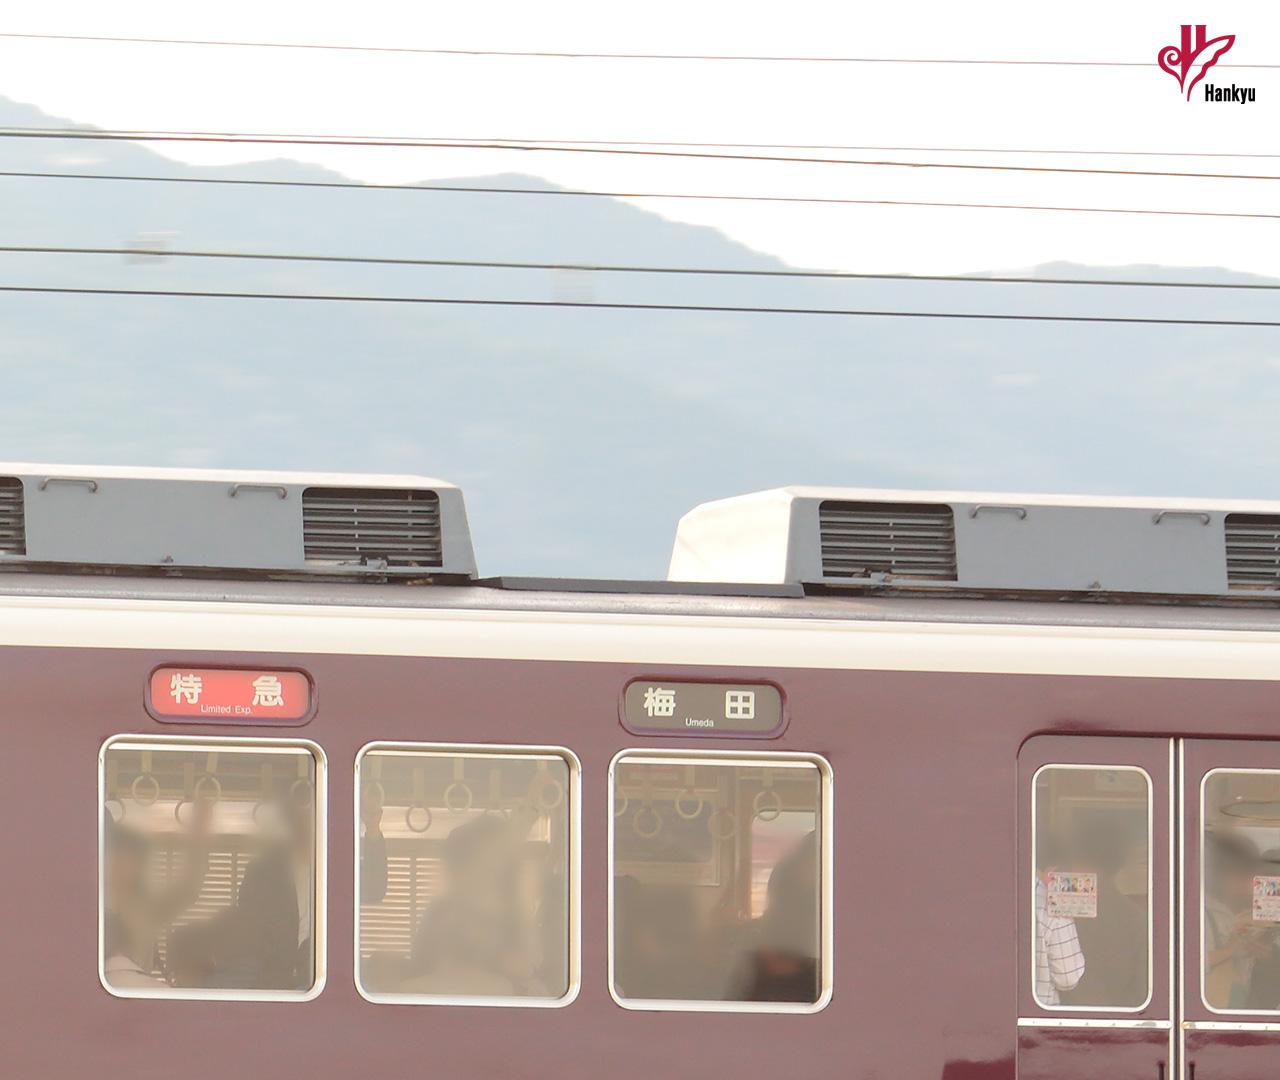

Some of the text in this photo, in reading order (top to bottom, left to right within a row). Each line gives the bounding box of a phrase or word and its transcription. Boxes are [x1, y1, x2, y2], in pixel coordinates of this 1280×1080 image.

[170, 673, 285, 707] 特急
[200, 704, 231, 714] Limited
[643, 686, 756, 720] 梅田
[685, 717, 715, 728] Umeda
